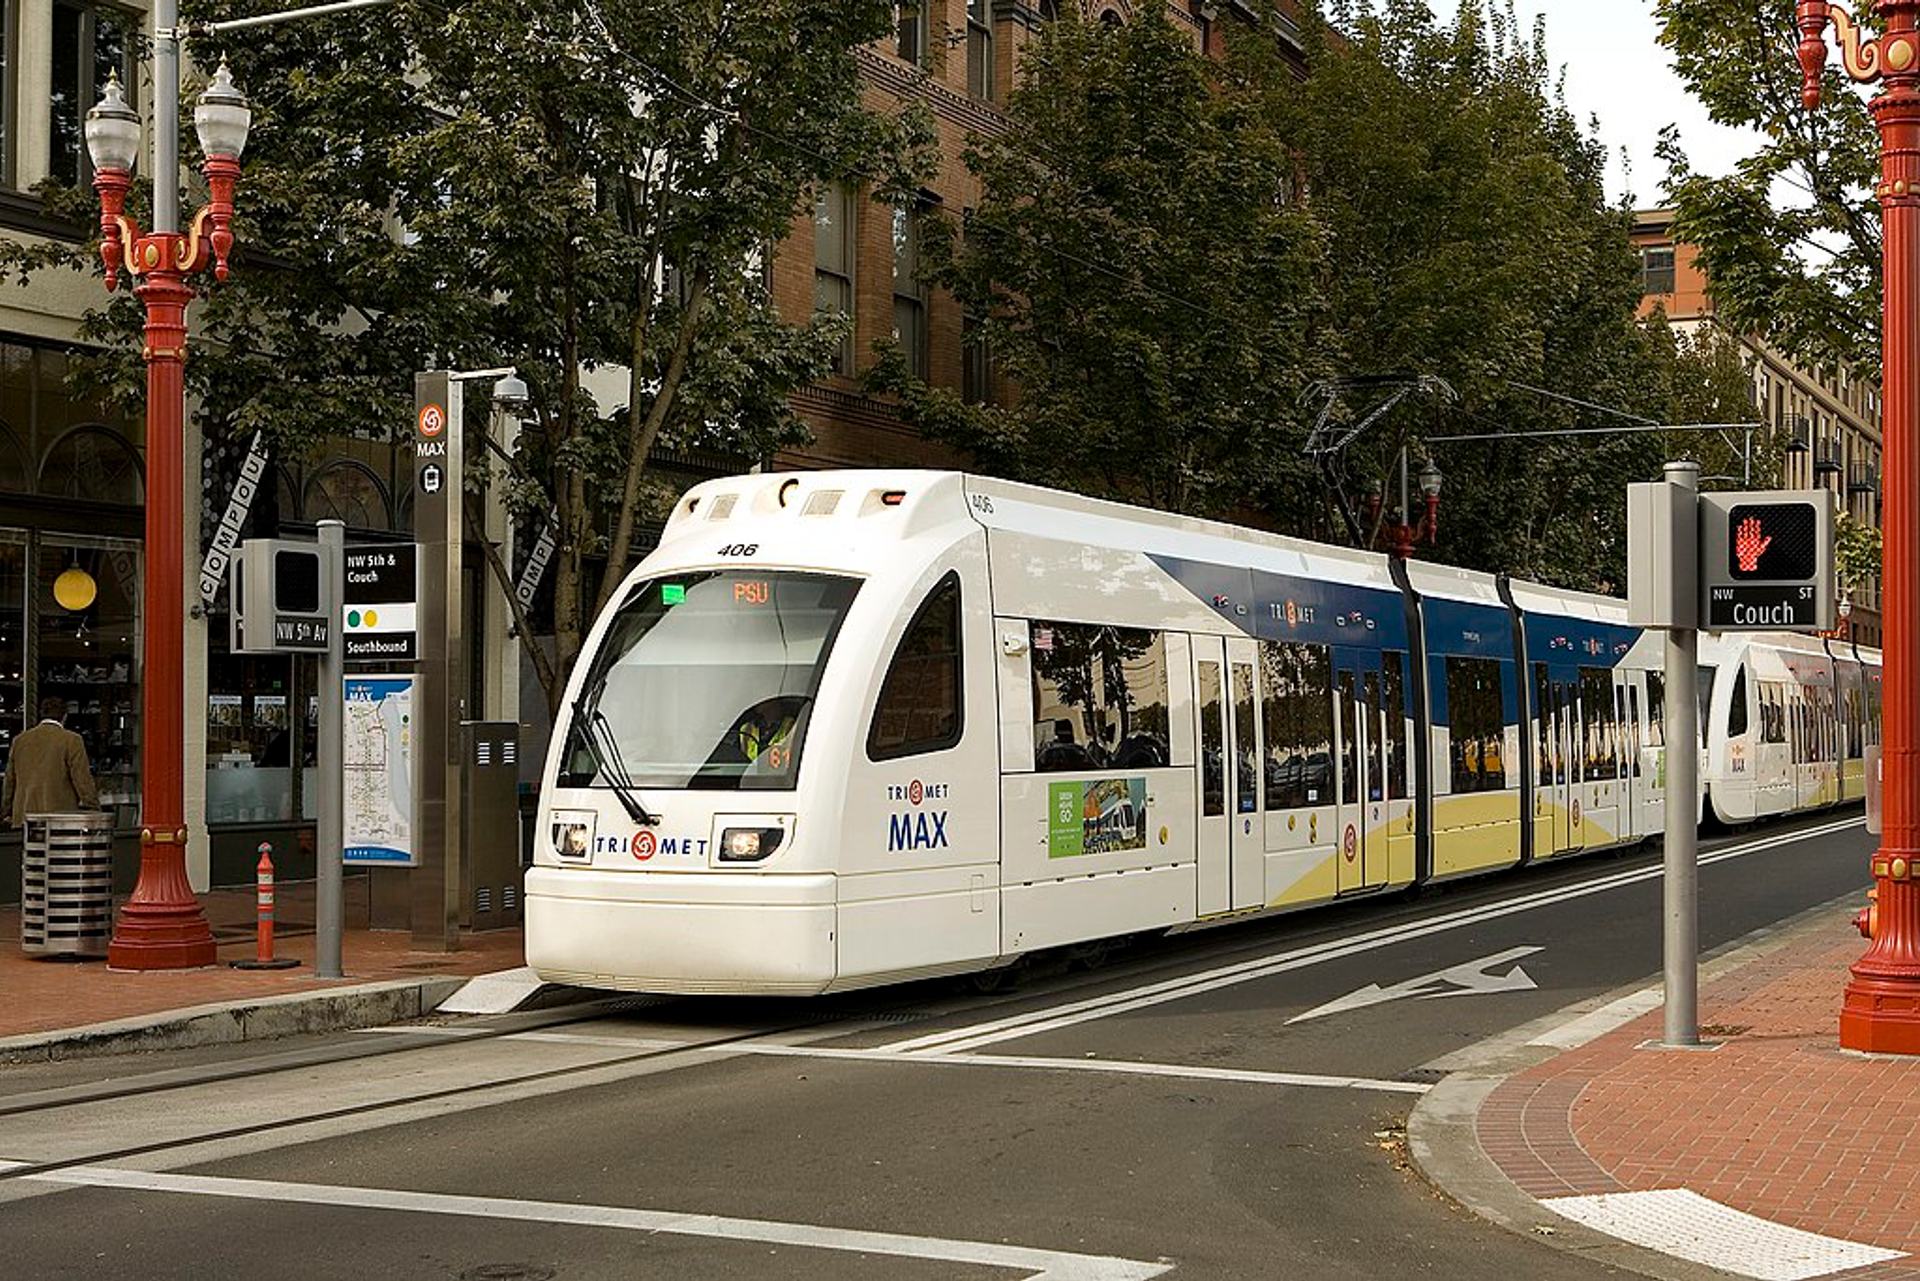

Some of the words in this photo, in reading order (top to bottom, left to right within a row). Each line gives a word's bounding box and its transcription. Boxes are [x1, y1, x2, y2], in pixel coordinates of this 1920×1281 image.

[417, 441, 446, 457] MAX
[971, 494, 994, 514] 406
[717, 543, 759, 556] 406
[348, 555, 365, 568] NW
[368, 554, 385, 567] 5th
[387, 554, 396, 566] &
[348, 570, 378, 583] Couch
[734, 581, 769, 603] PSU
[1713, 589, 1734, 600] NW
[1799, 587, 1813, 600] ST
[1733, 600, 1794, 624] Couch
[276, 622, 294, 640] NW
[297, 622, 311, 641] 5th
[313, 624, 327, 642] Av
[347, 640, 408, 654] Southbound
[888, 810, 948, 851] MAX
